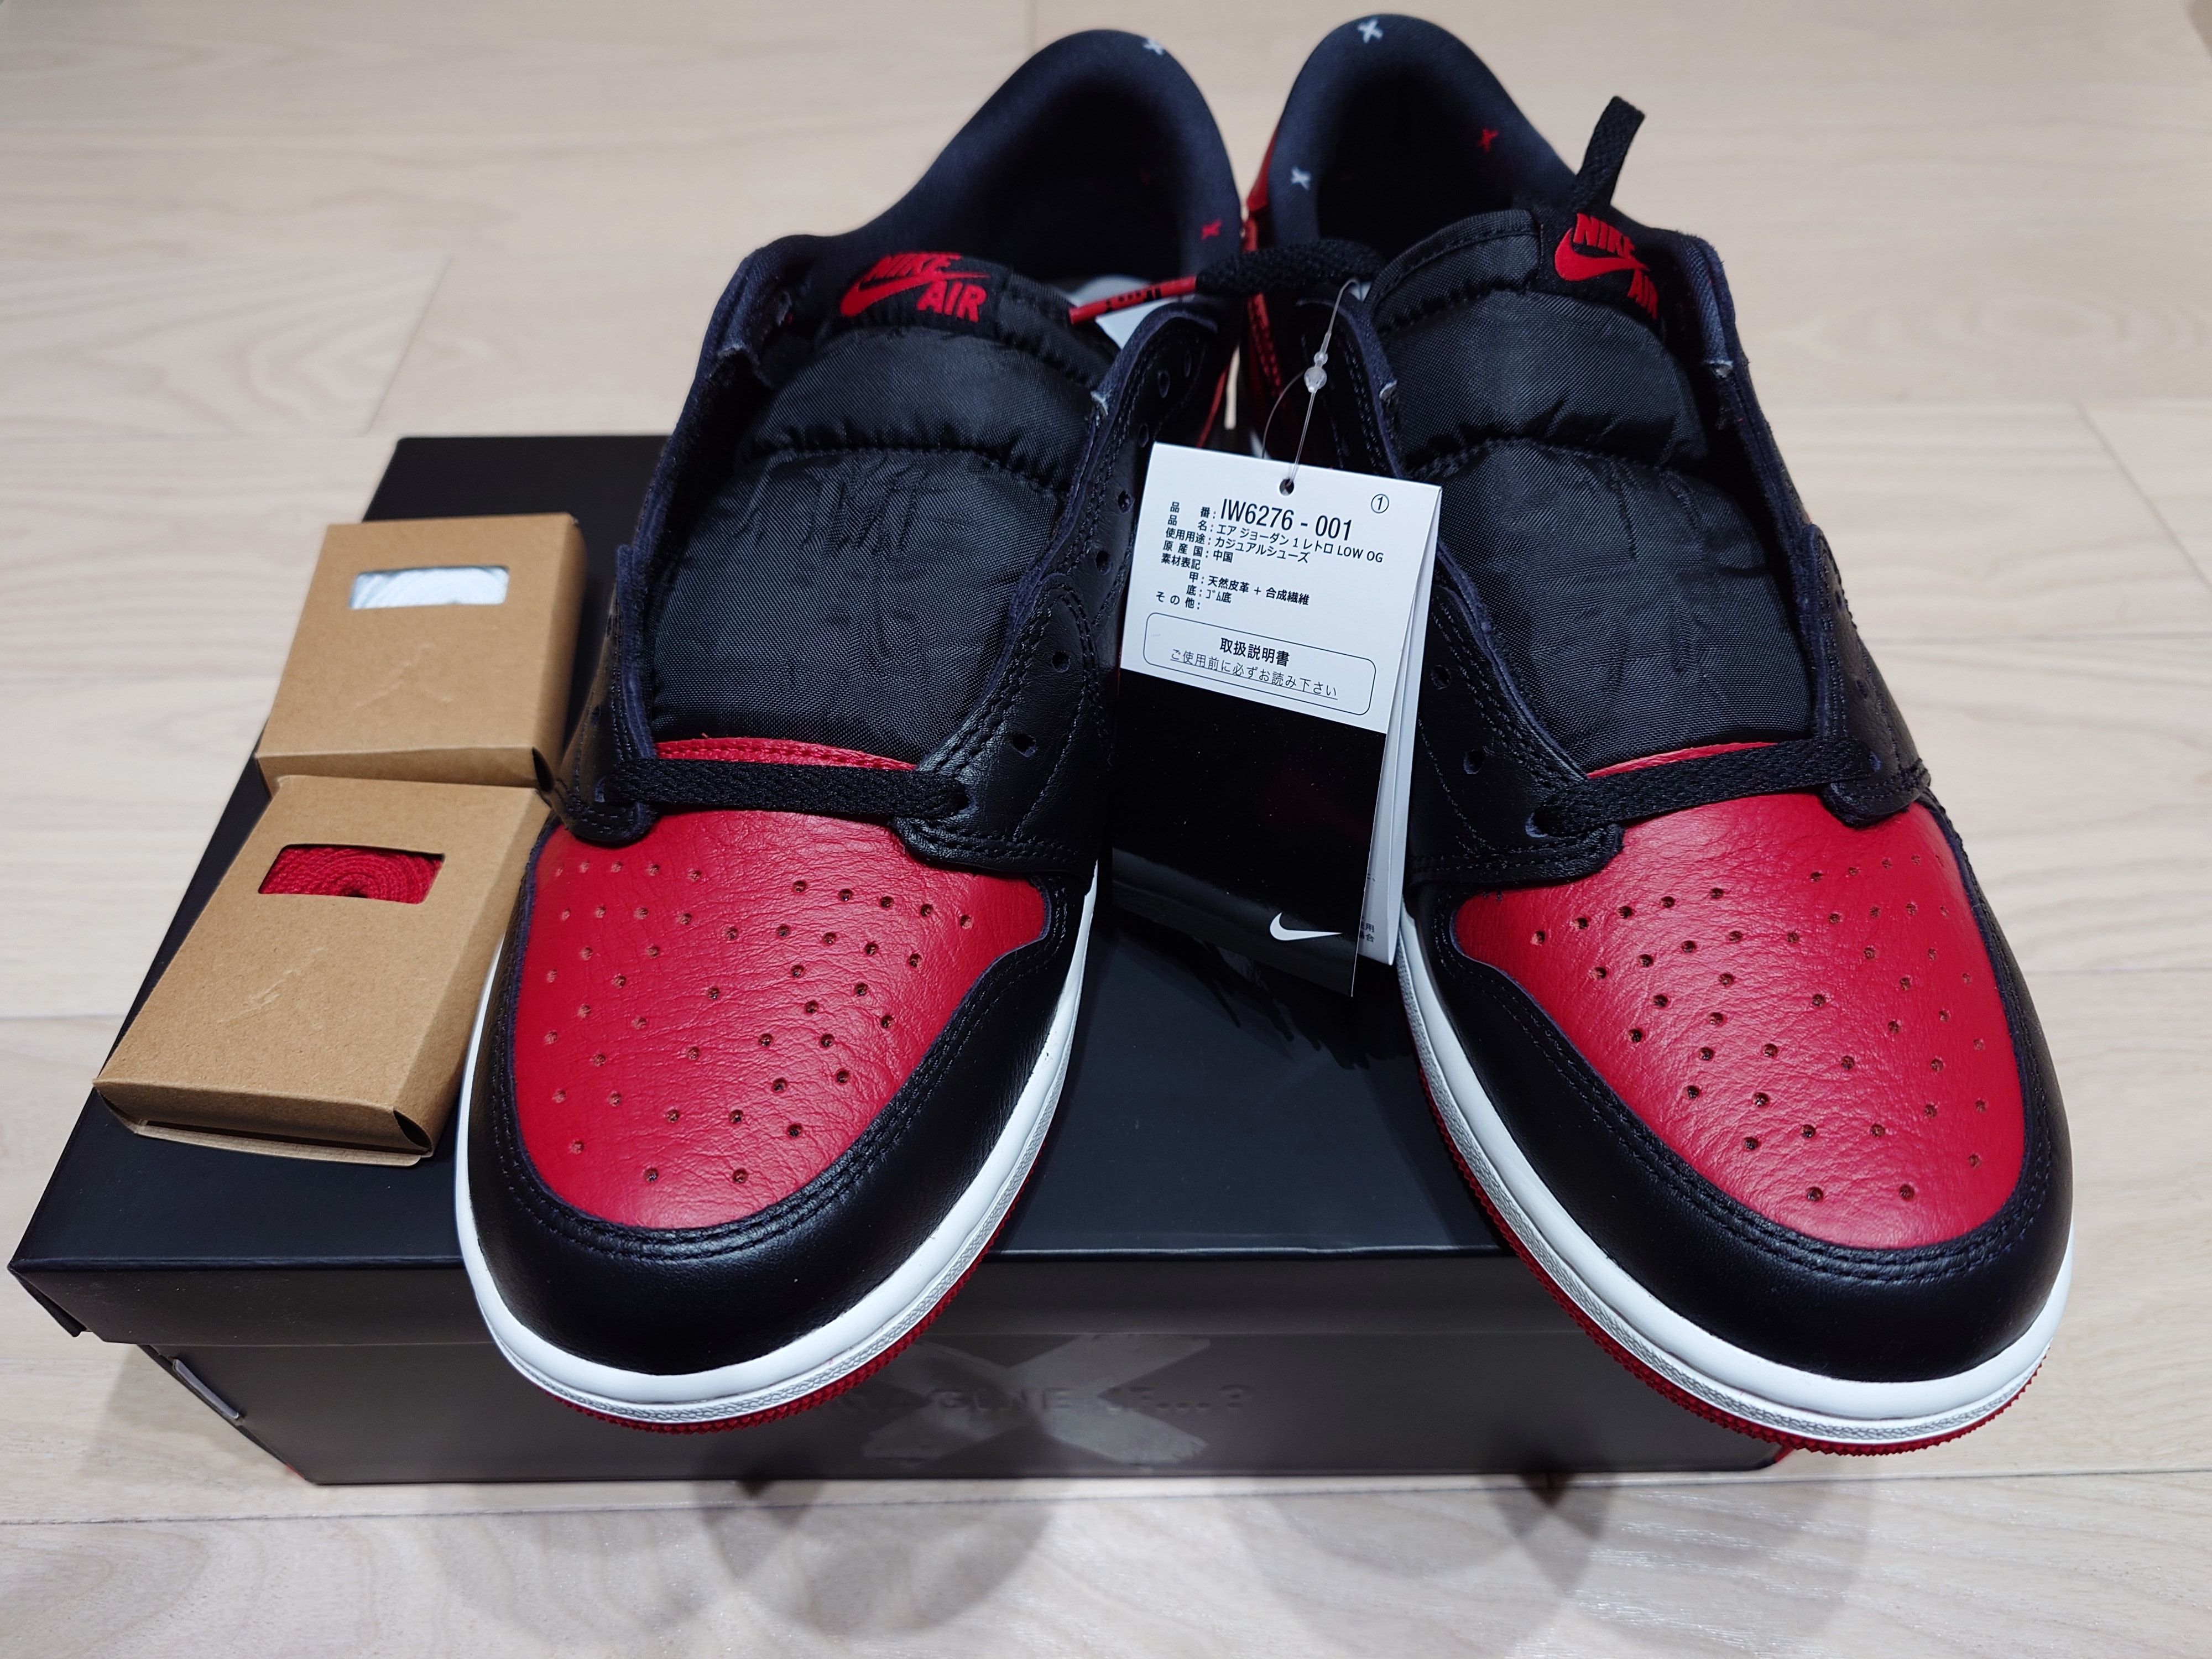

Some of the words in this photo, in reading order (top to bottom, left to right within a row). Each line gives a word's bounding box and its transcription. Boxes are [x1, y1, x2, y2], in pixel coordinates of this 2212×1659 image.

[1573, 212, 1635, 258] NIKE
[861, 252, 962, 283] NIKE
[916, 280, 988, 322] AIR
[1220, 498, 1295, 531] IW6276
[1315, 515, 1352, 541] 001
[1161, 553, 1201, 570] 素材表記
[1213, 549, 1233, 563] 中国
[1214, 536, 1311, 564] カジュアルシューズ
[1337, 545, 1364, 559] LOW
[1366, 550, 1384, 563] OG
[1219, 637, 1290, 667] 取扱説明書
[1171, 649, 1337, 696] ご使用前に必ずお読み下さい
